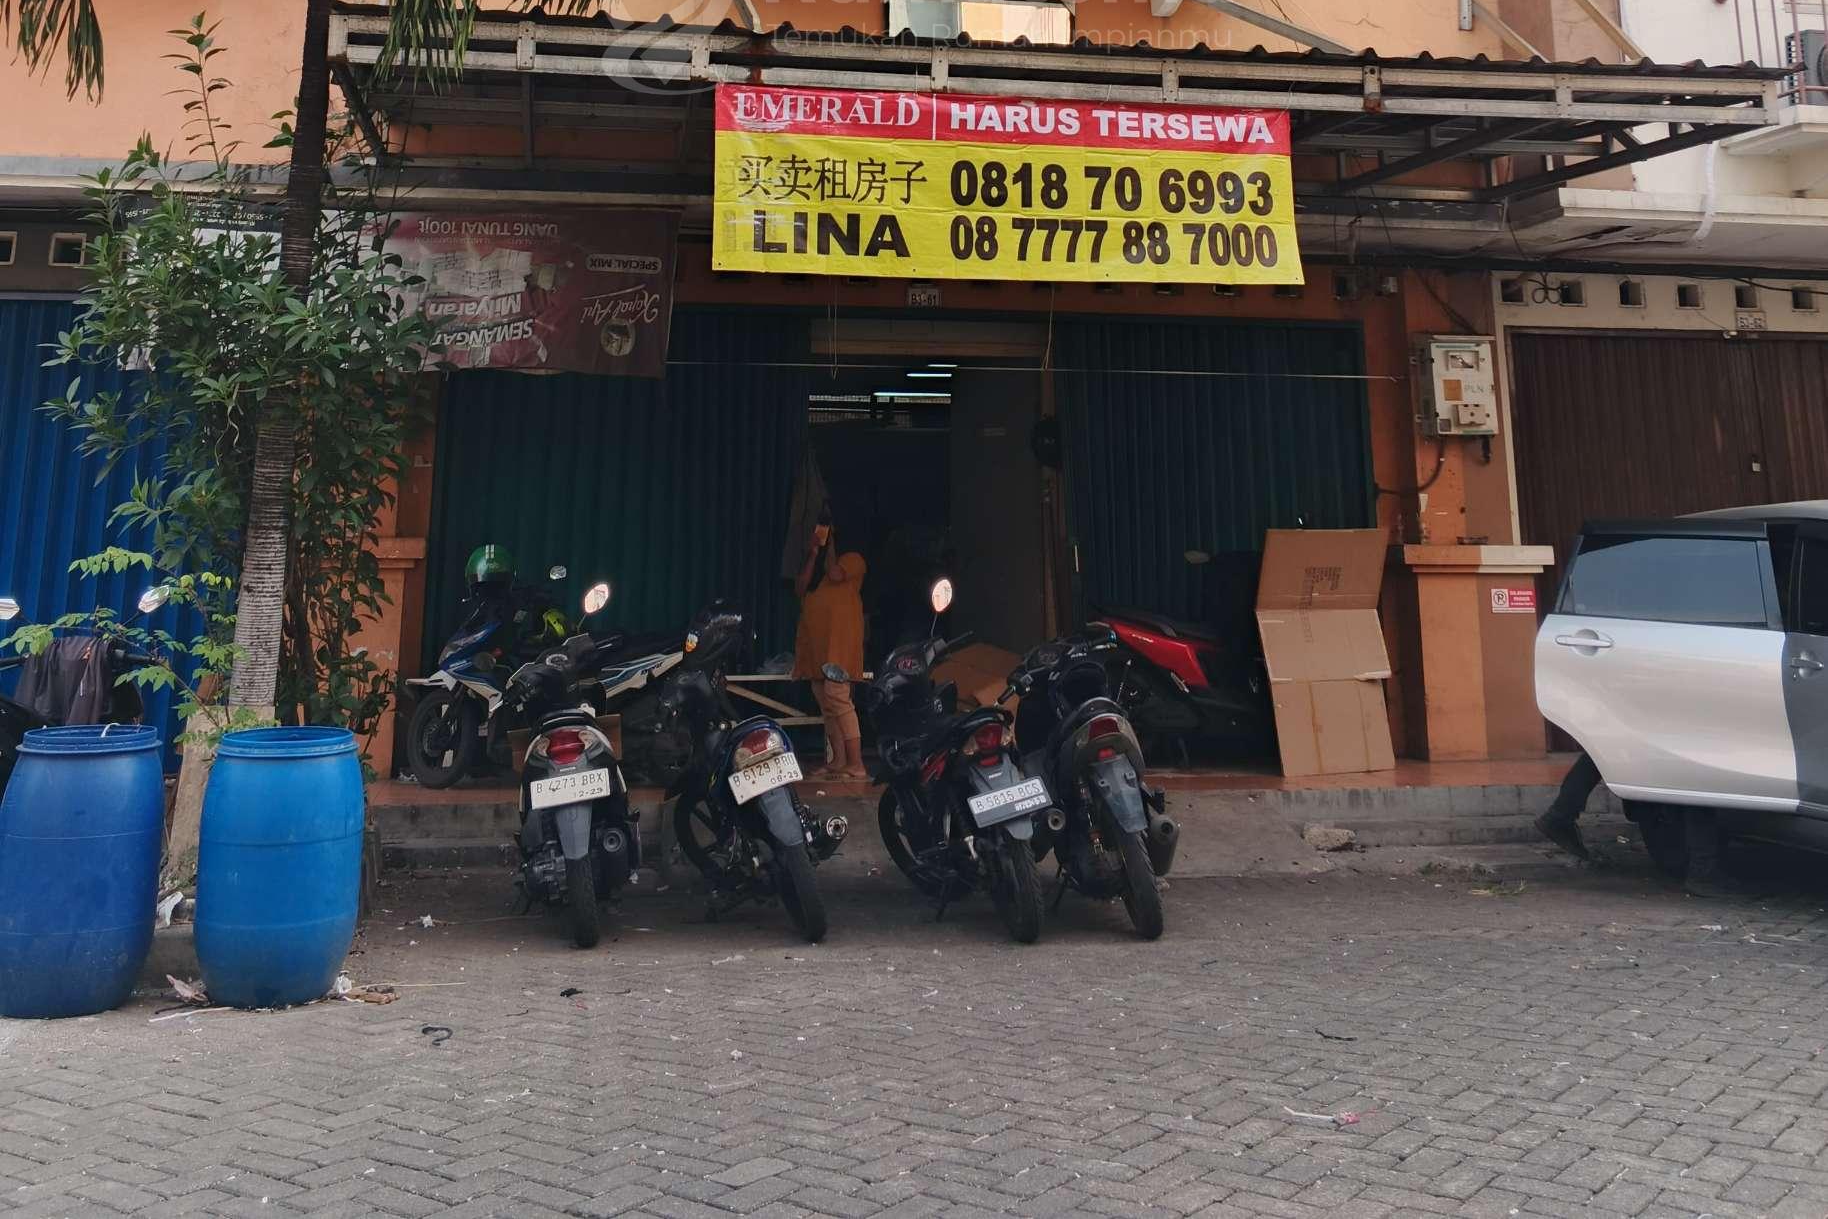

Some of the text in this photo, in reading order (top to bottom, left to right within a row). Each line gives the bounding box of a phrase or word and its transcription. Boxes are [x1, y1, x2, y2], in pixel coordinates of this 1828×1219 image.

[736, 92, 1275, 144] EMERALD HARUS TERSEWA
[738, 154, 928, 204] 买卖租房子
[950, 160, 1274, 216] 0818 70 6993
[753, 209, 911, 257] LINA
[950, 215, 1278, 268] 08 7777 88 7000
[590, 258, 612, 269] MIX
[431, 319, 534, 347] SEMANGAT
[536, 783, 543, 794] B
